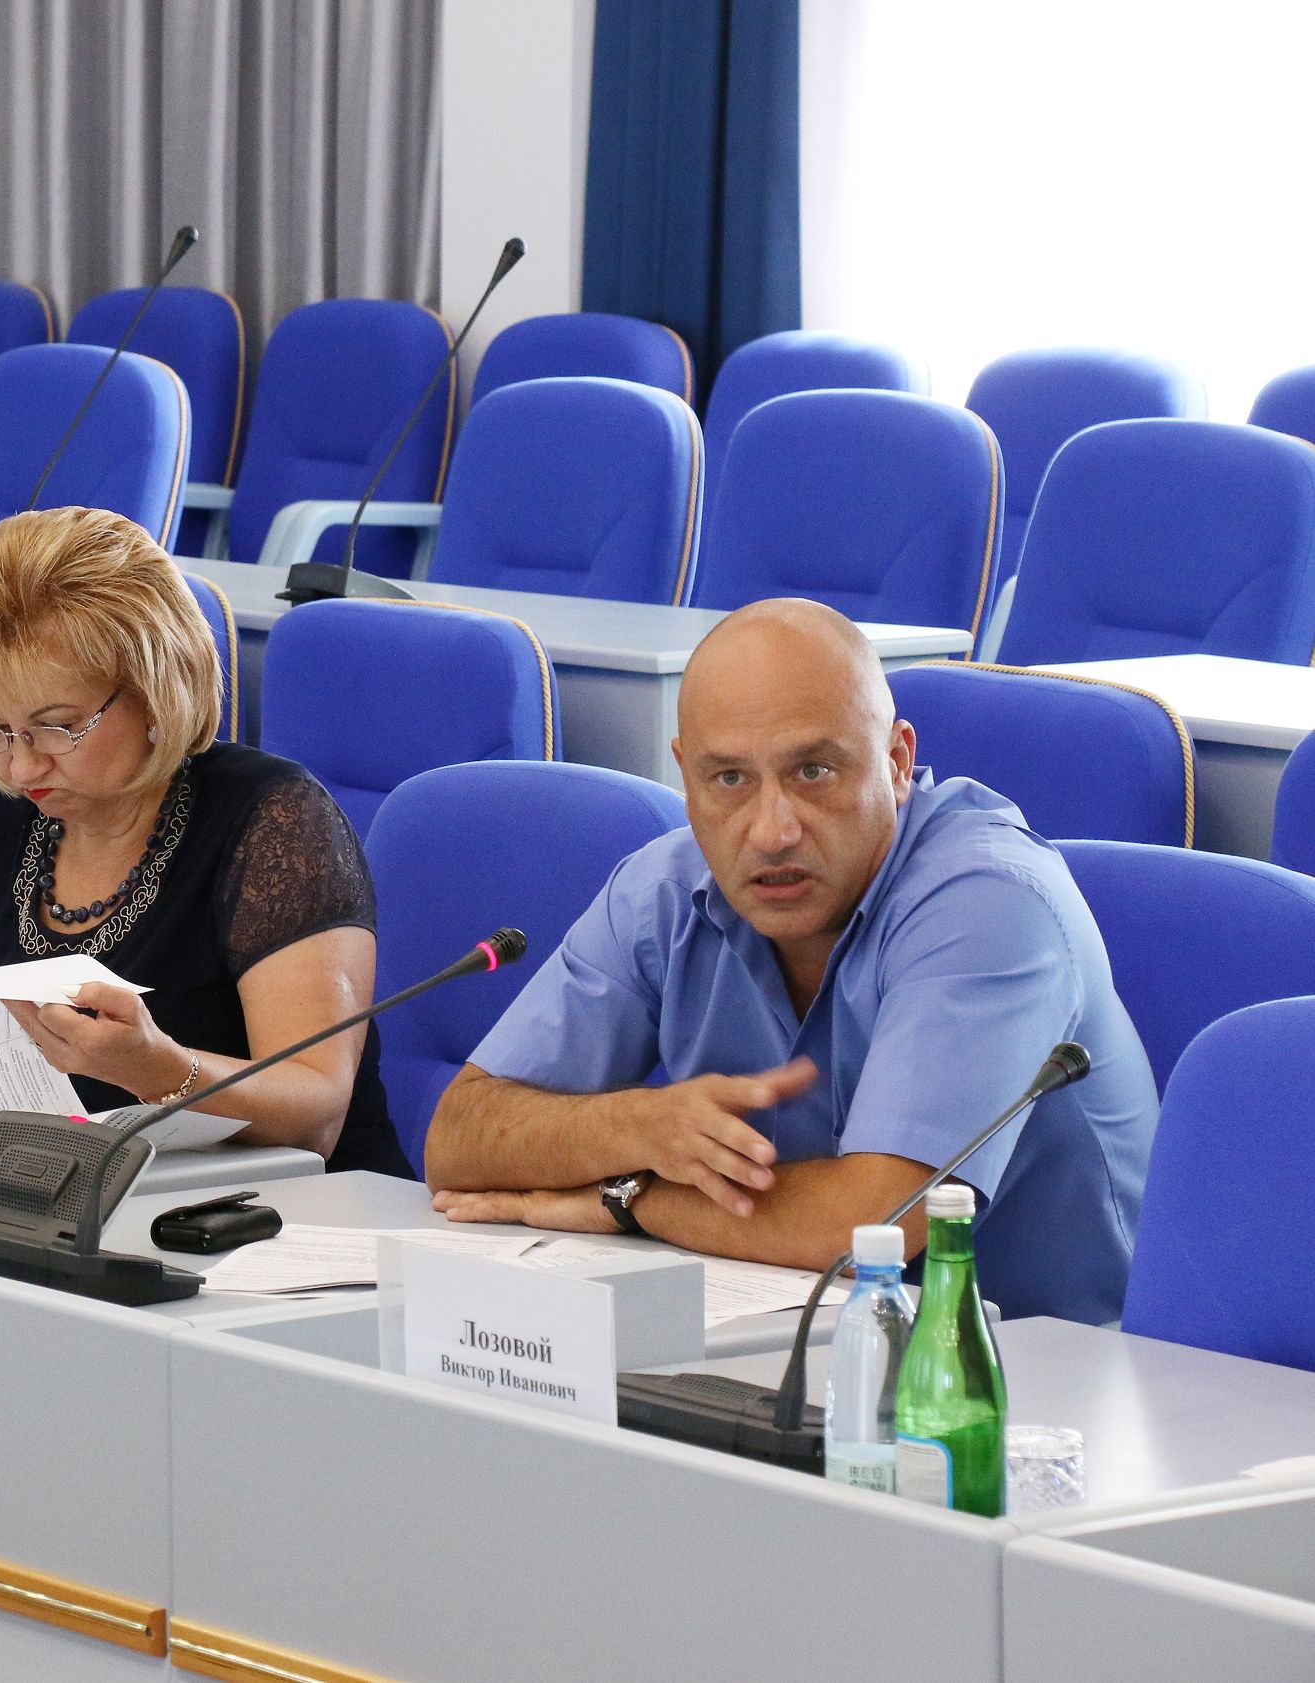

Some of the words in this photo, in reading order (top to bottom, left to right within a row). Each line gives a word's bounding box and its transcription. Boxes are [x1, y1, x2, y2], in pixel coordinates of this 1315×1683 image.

[459, 1319, 553, 1365] Лозовой
[440, 1354, 495, 1388] Виктор
[499, 1367, 577, 1402] Иванович
